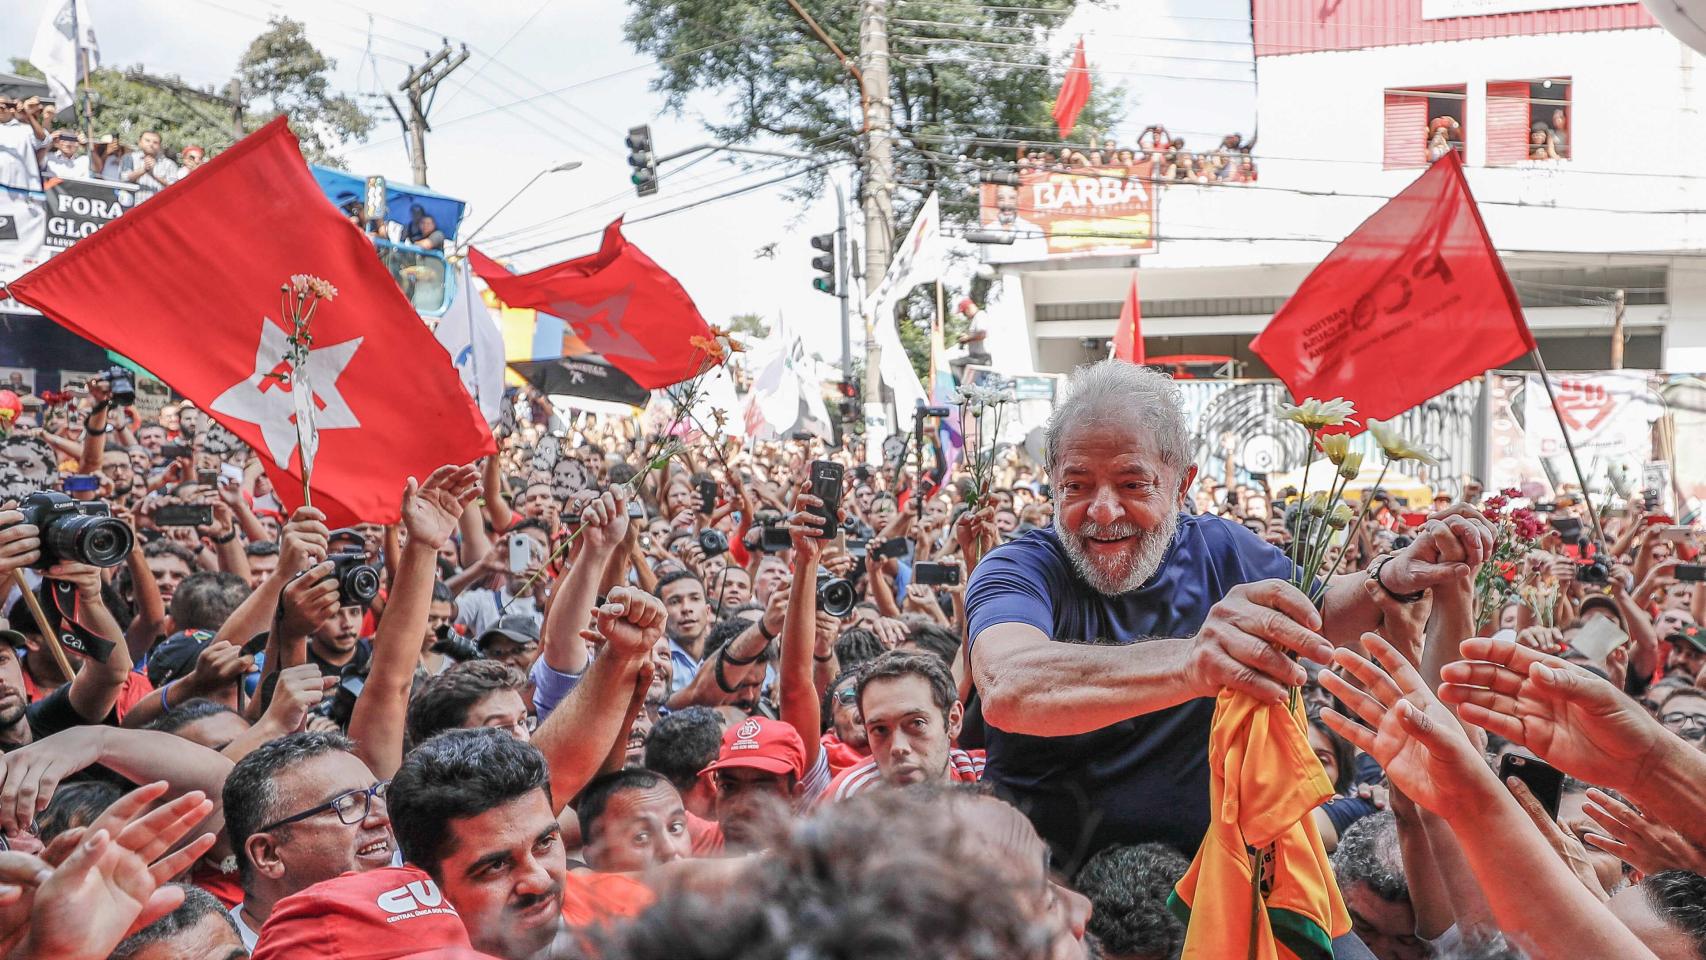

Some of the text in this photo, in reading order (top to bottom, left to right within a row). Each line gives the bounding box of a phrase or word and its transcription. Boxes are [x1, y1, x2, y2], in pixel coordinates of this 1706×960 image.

[1033, 177, 1148, 209] BARBA
[58, 194, 123, 219] FORA
[48, 217, 104, 239] GLO
[386, 912, 415, 923] CENTRAL
